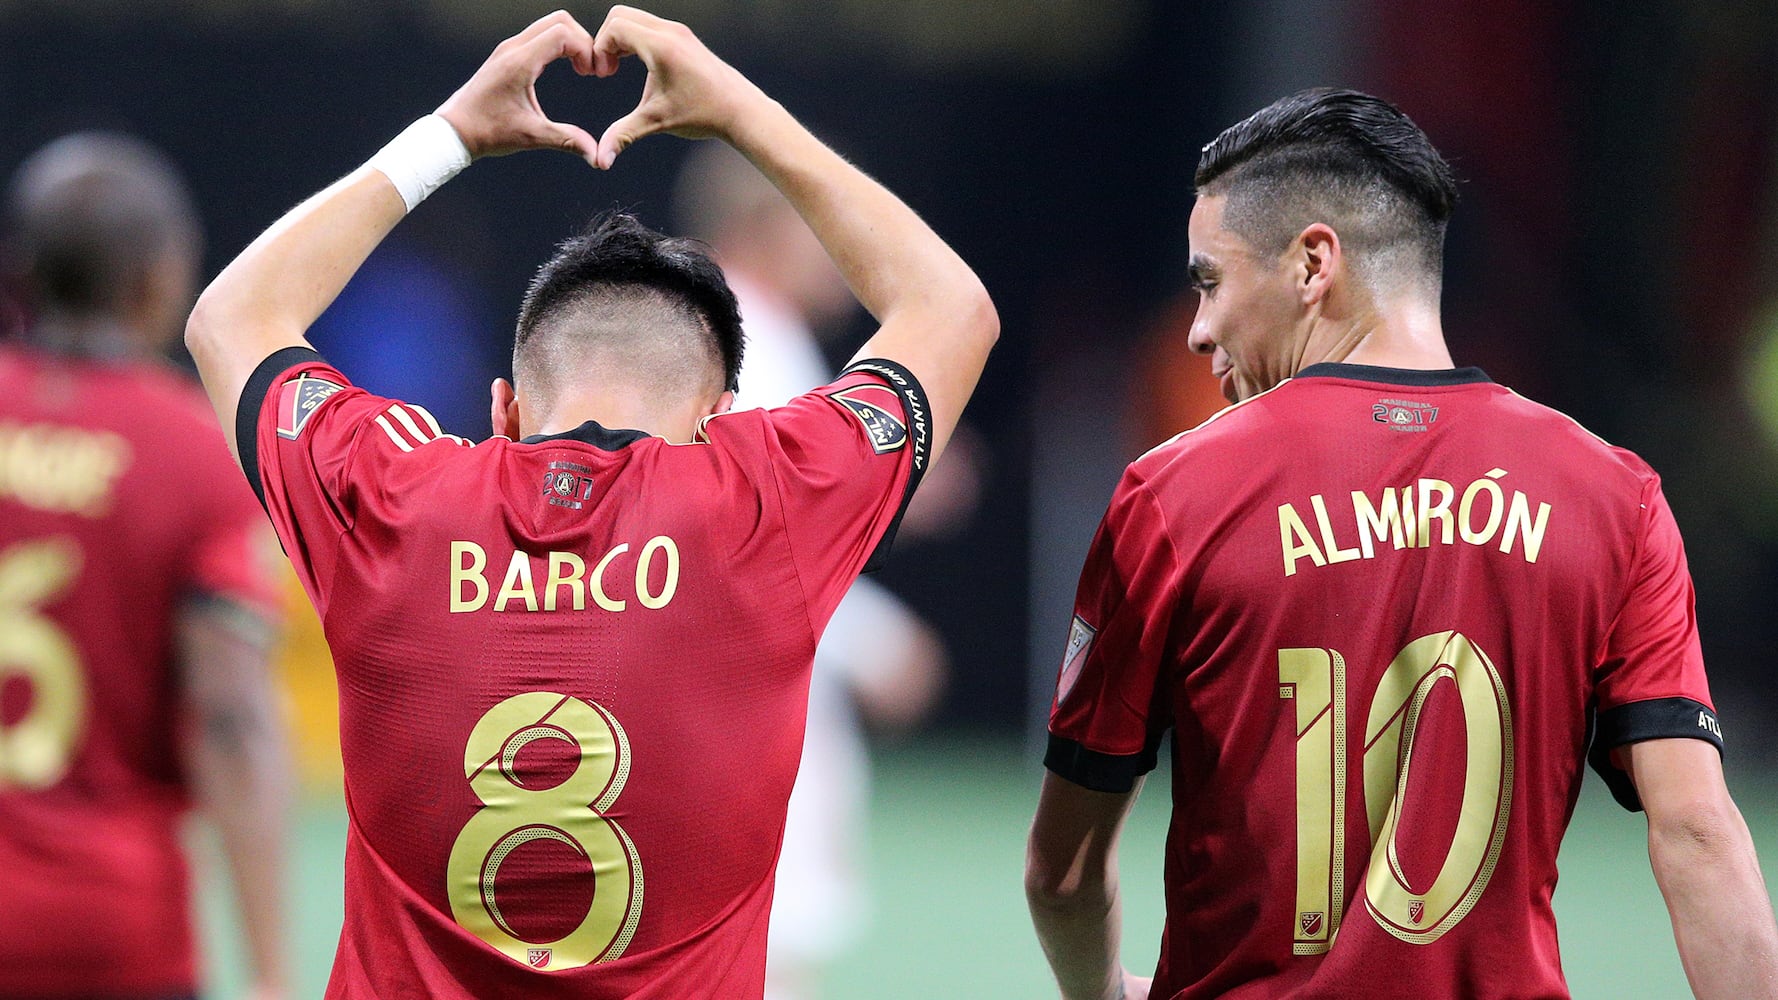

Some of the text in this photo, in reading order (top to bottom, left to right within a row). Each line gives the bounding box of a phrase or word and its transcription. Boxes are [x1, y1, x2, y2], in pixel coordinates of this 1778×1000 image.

[859, 408, 889, 444] MLS
[904, 389, 926, 470] ATLANTA
[1278, 467, 1552, 576] ALMIRÓN
[450, 535, 680, 613] BARCO
[447, 691, 645, 971] 8
[1278, 630, 1514, 956] 10
